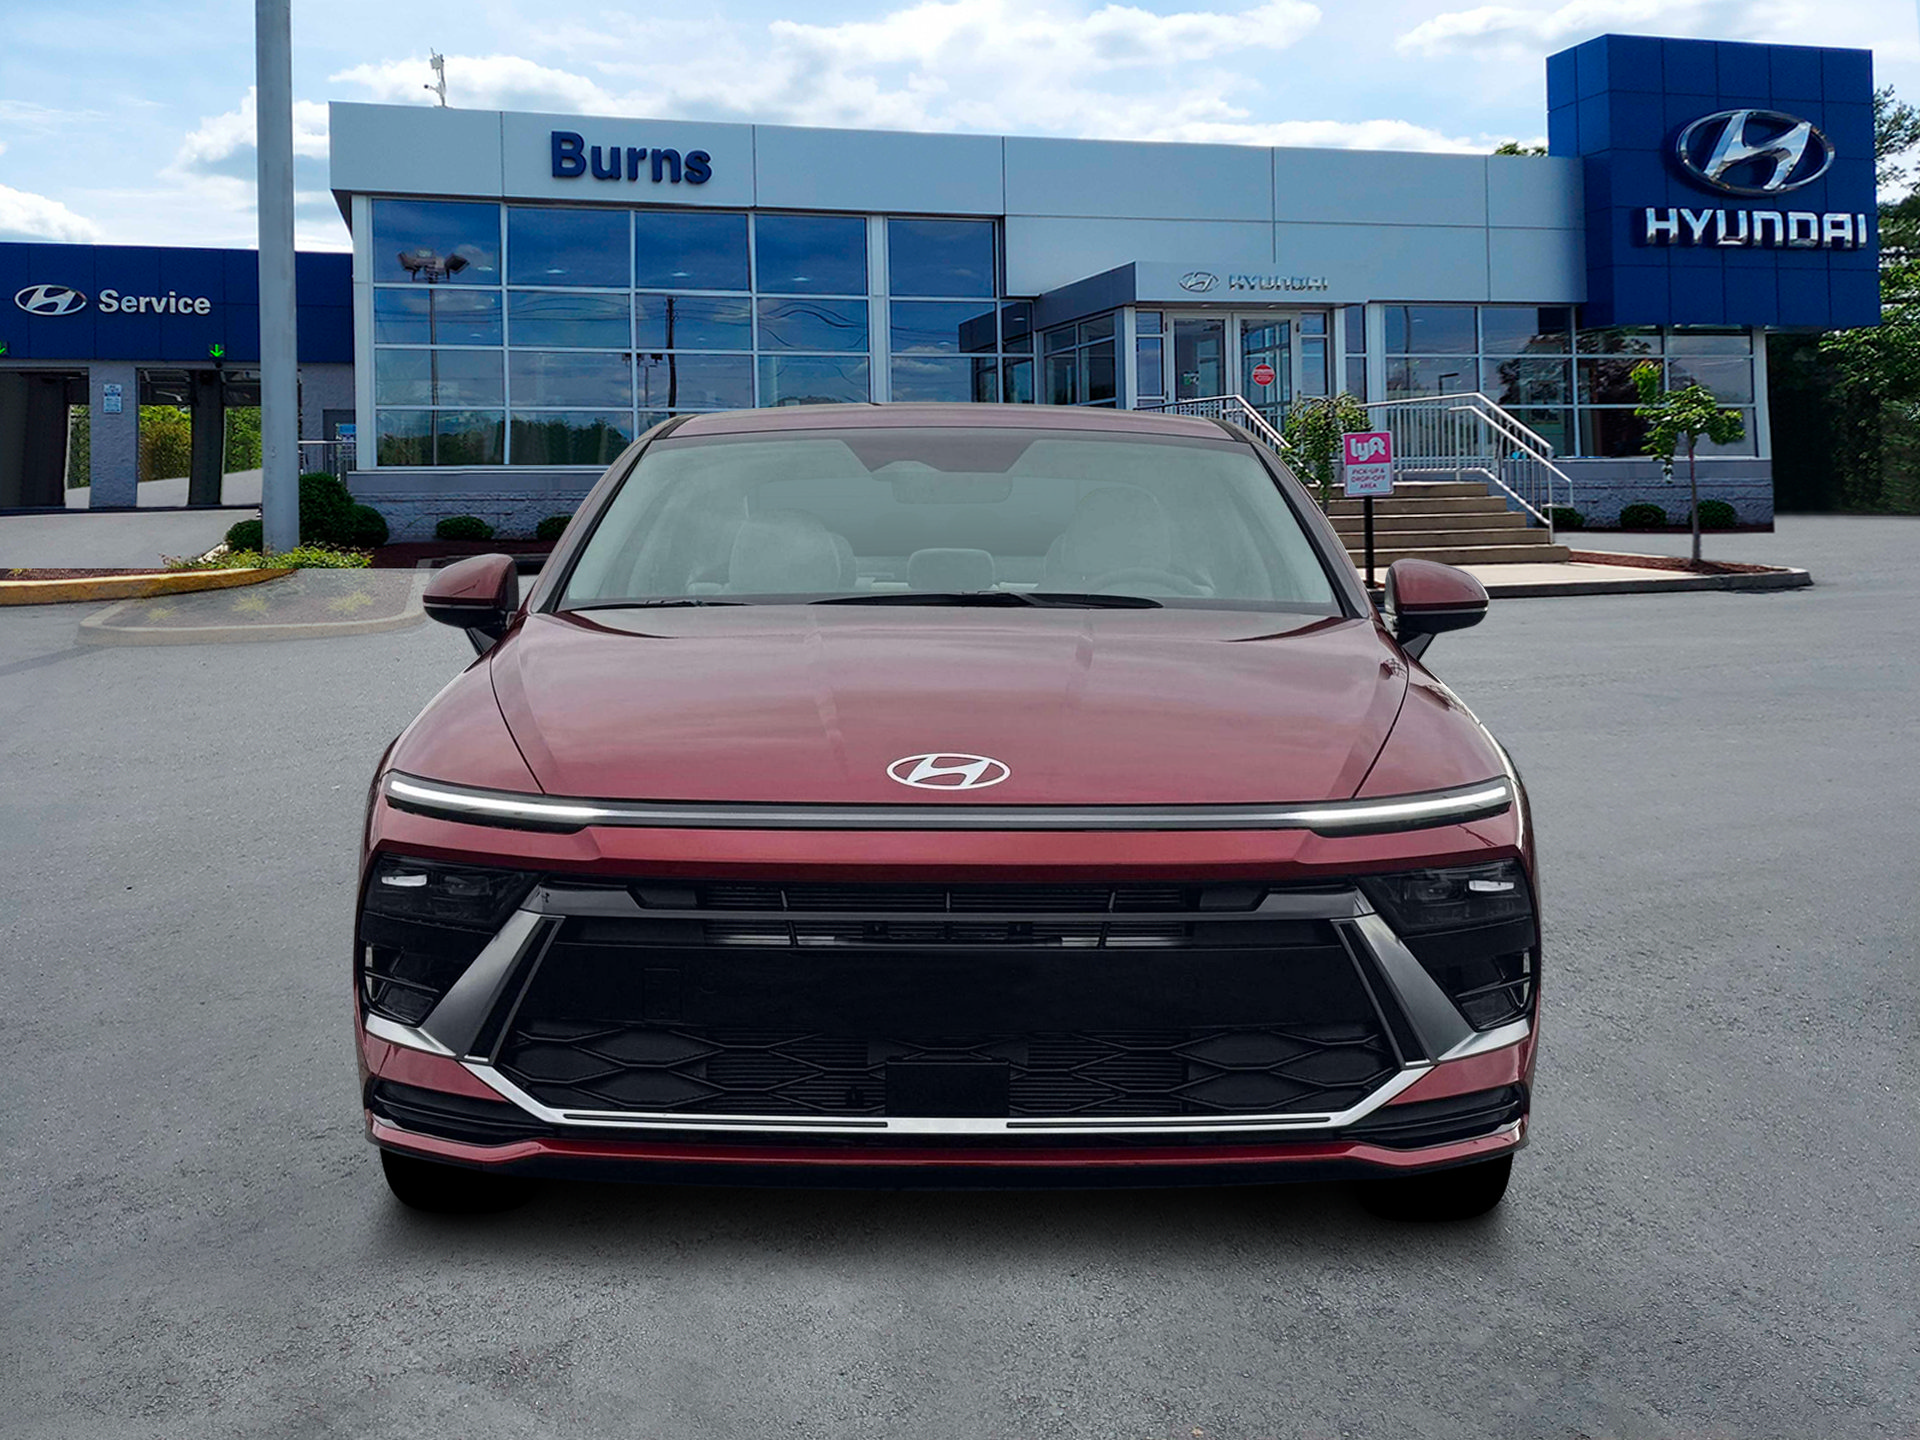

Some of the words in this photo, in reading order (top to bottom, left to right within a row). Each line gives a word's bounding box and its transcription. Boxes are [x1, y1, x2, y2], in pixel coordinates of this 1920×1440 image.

[551, 130, 712, 185] Burns
[1645, 207, 1868, 248] HYUNDAI
[1228, 274, 1329, 291] HYUNDAI
[98, 288, 211, 315] Service
